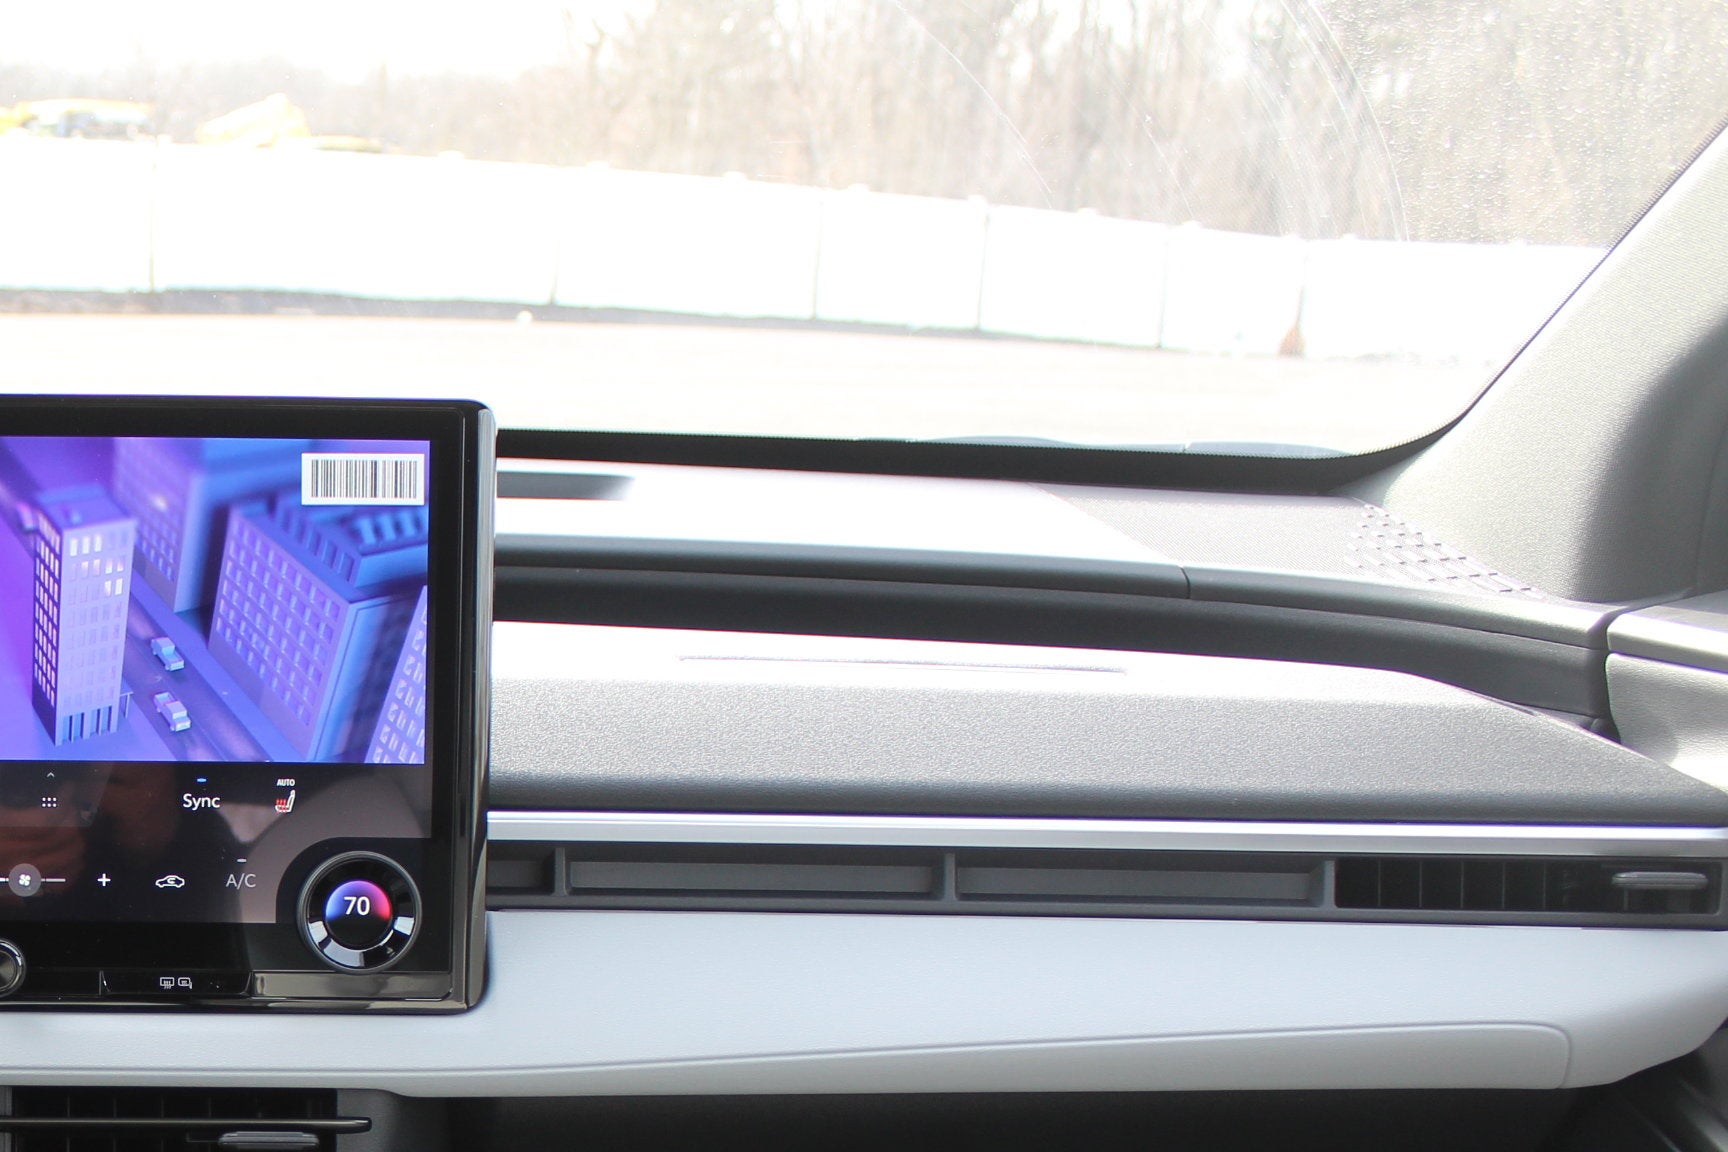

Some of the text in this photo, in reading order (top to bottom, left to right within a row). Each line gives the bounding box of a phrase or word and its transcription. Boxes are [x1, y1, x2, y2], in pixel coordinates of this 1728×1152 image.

[276, 778, 295, 787] AUTO
[182, 793, 221, 811] Sync
[226, 872, 257, 889] A/C
[344, 896, 371, 916] 70
